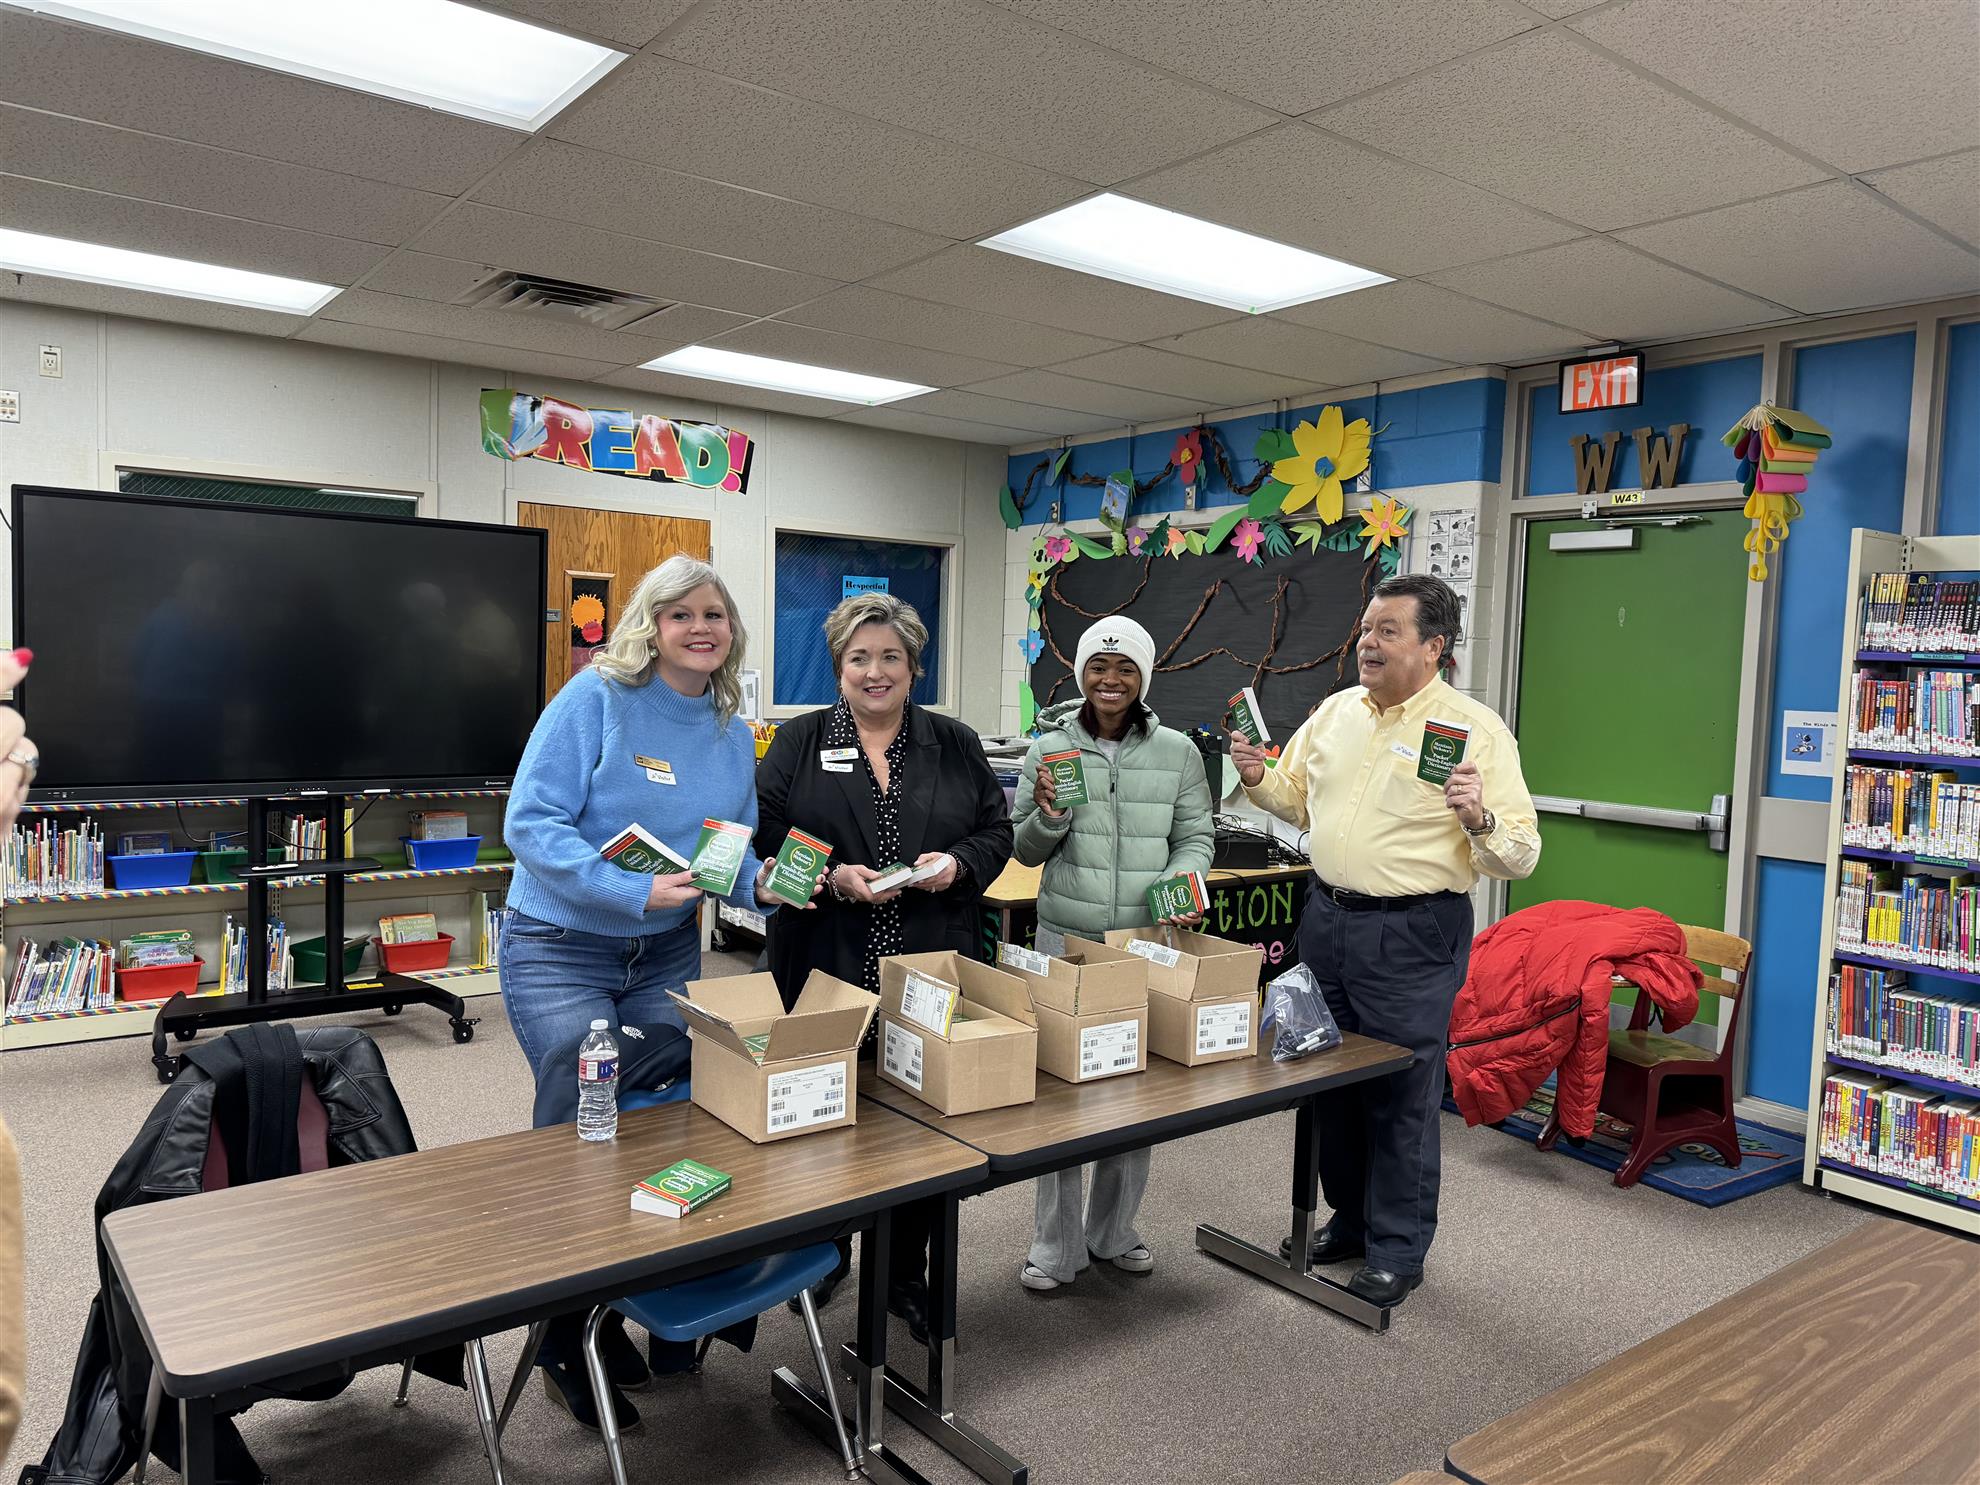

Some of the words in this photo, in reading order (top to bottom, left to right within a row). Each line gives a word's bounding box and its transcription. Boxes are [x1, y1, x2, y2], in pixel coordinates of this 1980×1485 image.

[1572, 357, 1634, 411] EXIT
[533, 395, 749, 493] READ!
[1569, 431, 1621, 496] W
[1632, 423, 1688, 490] W
[1614, 493, 1639, 504] W43
[845, 580, 886, 590] Respectful
[1432, 752, 1449, 760] Pocket
[1426, 760, 1452, 771] Dictionary
[779, 862, 814, 882] Spanish-English
[790, 861, 807, 873] Pocket
[780, 869, 806, 885] Dictionary
